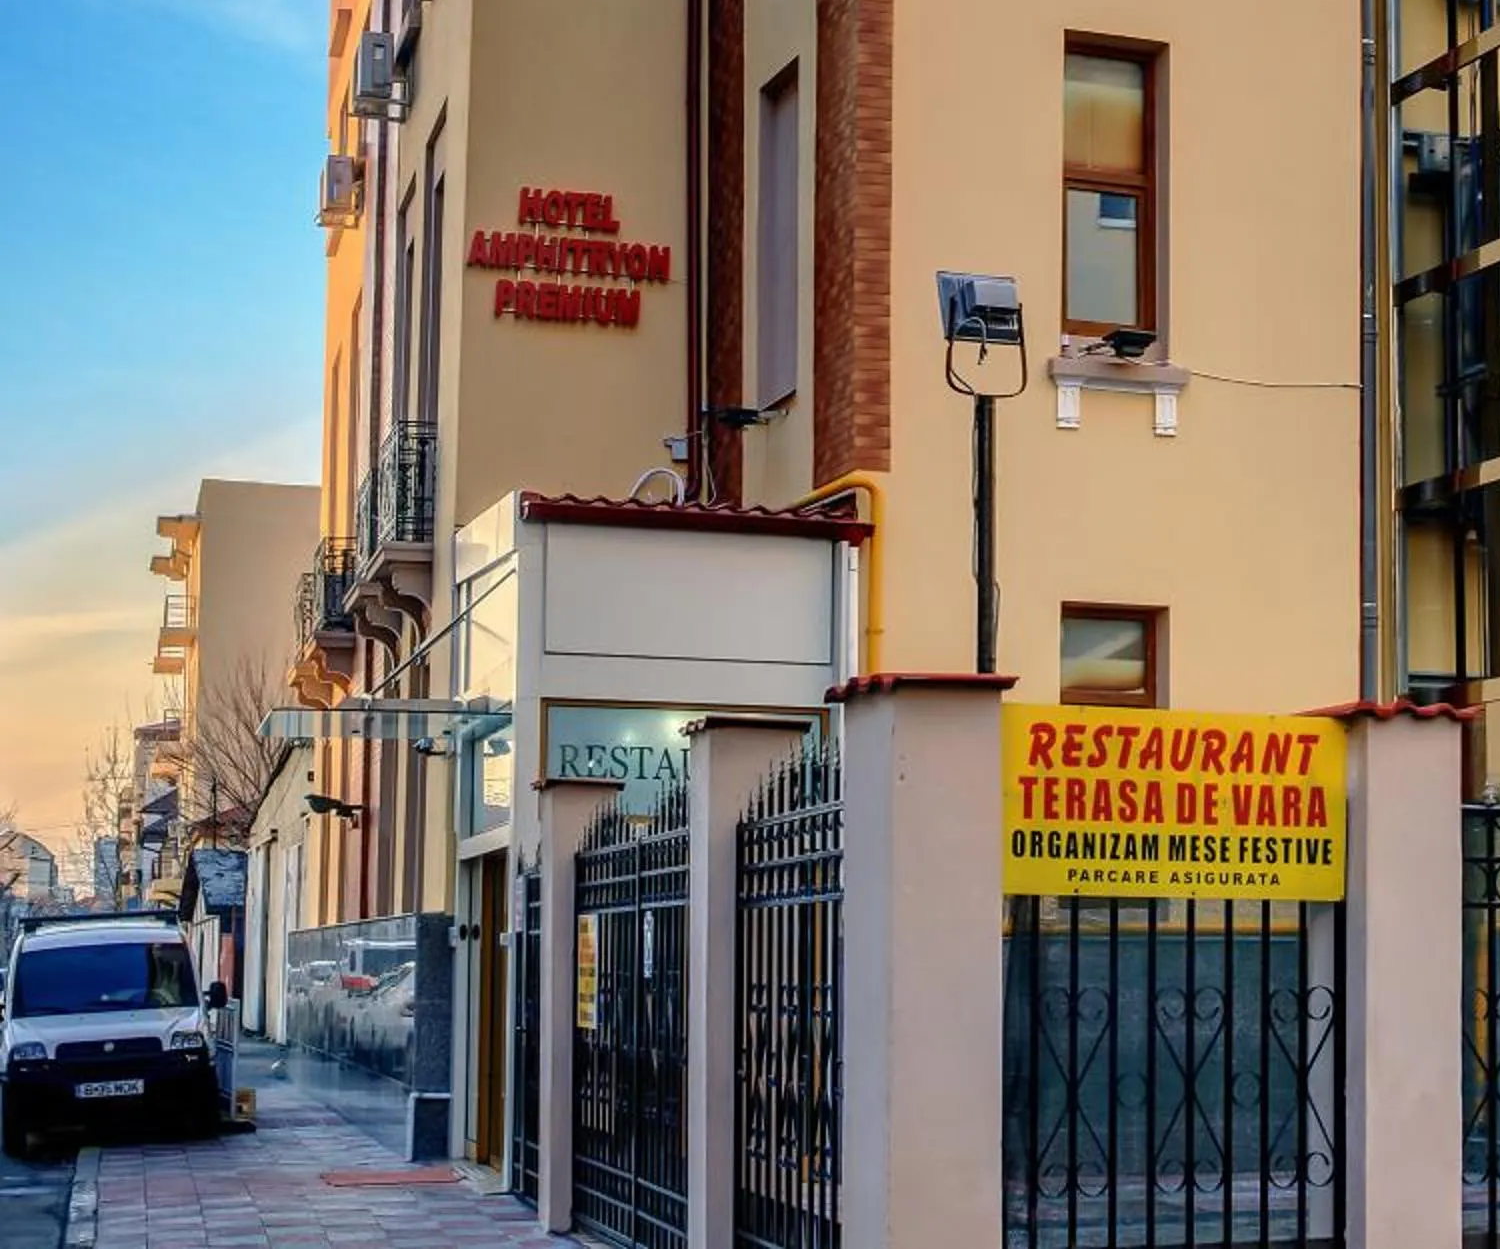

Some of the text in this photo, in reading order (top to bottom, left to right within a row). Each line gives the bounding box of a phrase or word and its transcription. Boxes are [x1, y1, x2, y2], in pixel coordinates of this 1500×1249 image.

[518, 187, 620, 233] HOTEL
[466, 231, 671, 283] AMPHITRYON
[495, 279, 641, 328] PREMIUM
[1028, 722, 1320, 775] RESTAURANT
[1018, 776, 1328, 828] TERASA DE VARA
[1011, 829, 1333, 866] ORGANIZAM MESE FESTIVE
[1067, 868, 1281, 886] PARCARE ASIGURATA
